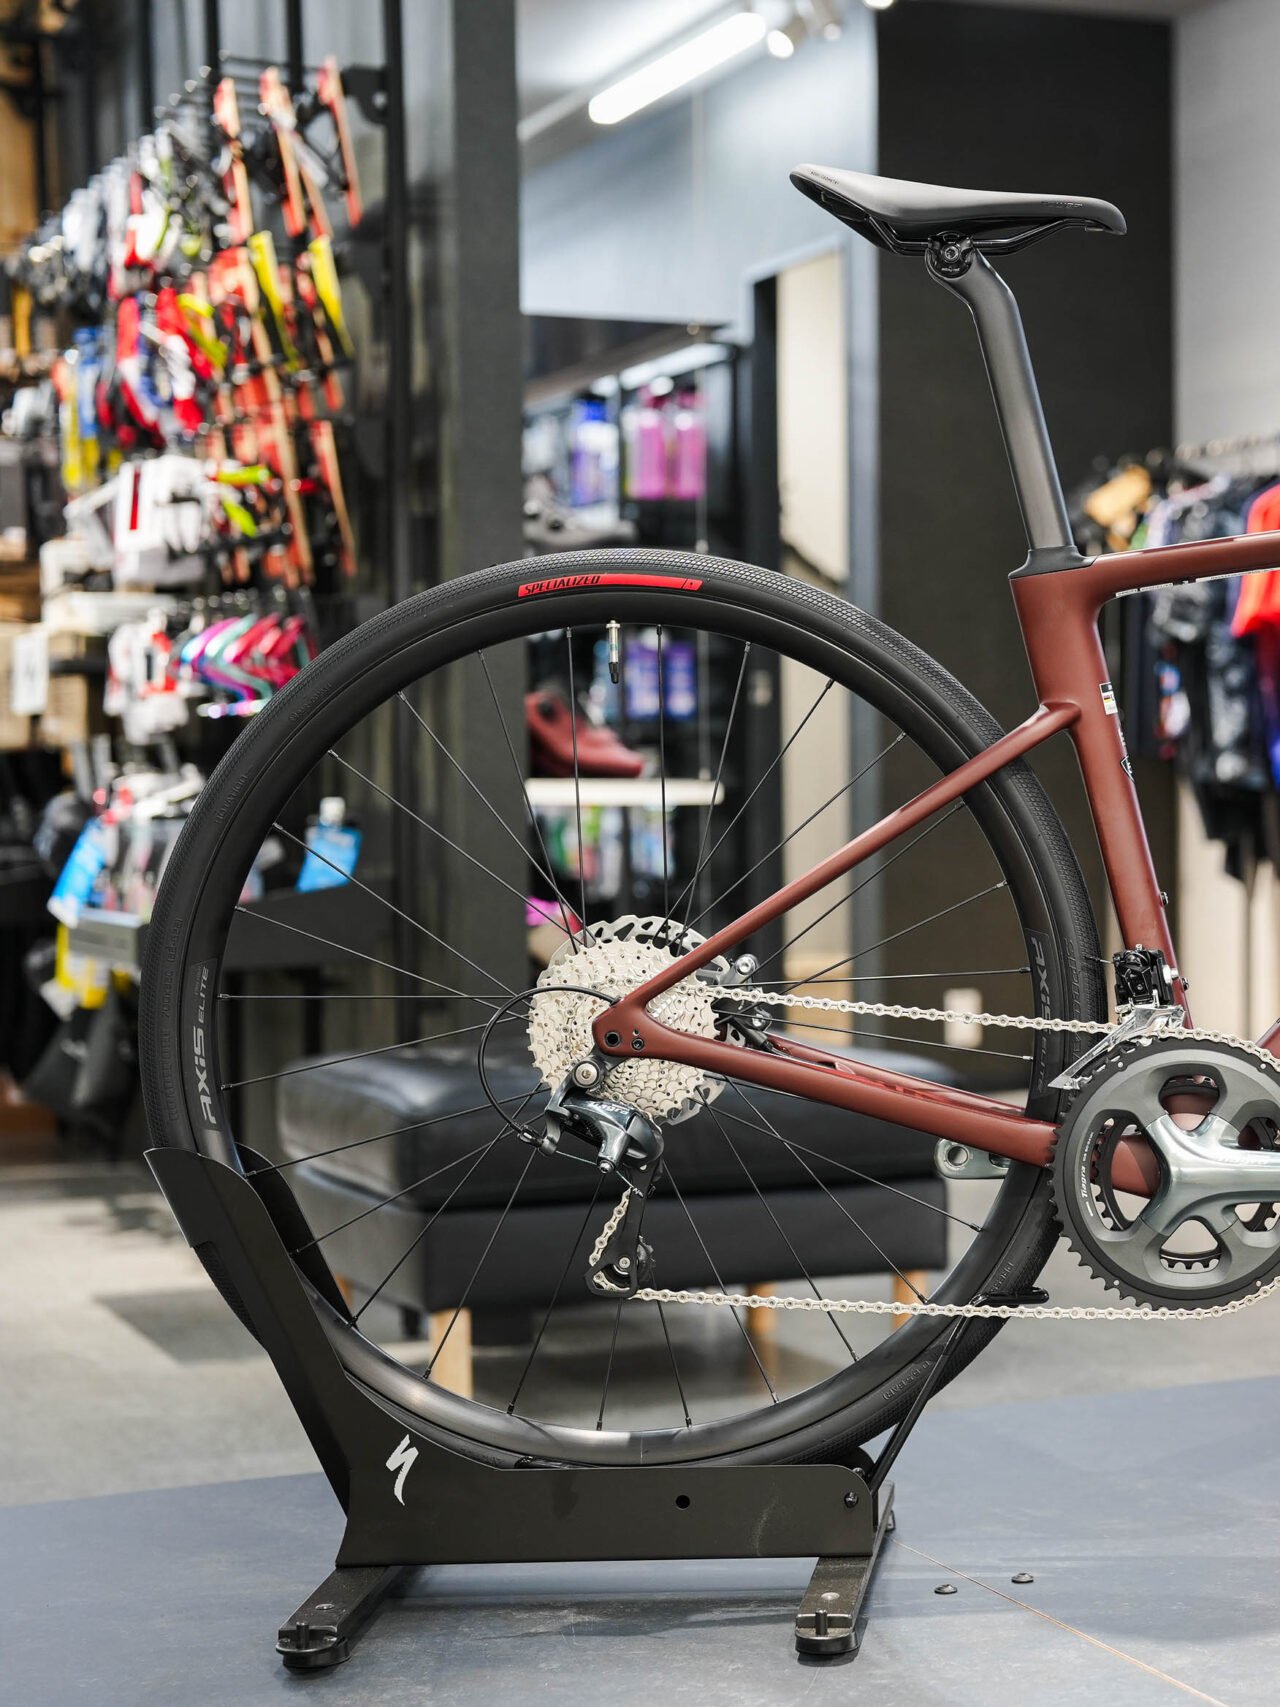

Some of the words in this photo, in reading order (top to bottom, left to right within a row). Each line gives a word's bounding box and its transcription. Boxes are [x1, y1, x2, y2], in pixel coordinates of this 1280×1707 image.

[524, 576, 601, 595] SPECIALIZED
[198, 966, 210, 1024] ELITE
[1080, 1165, 1088, 1199] Tiagra
